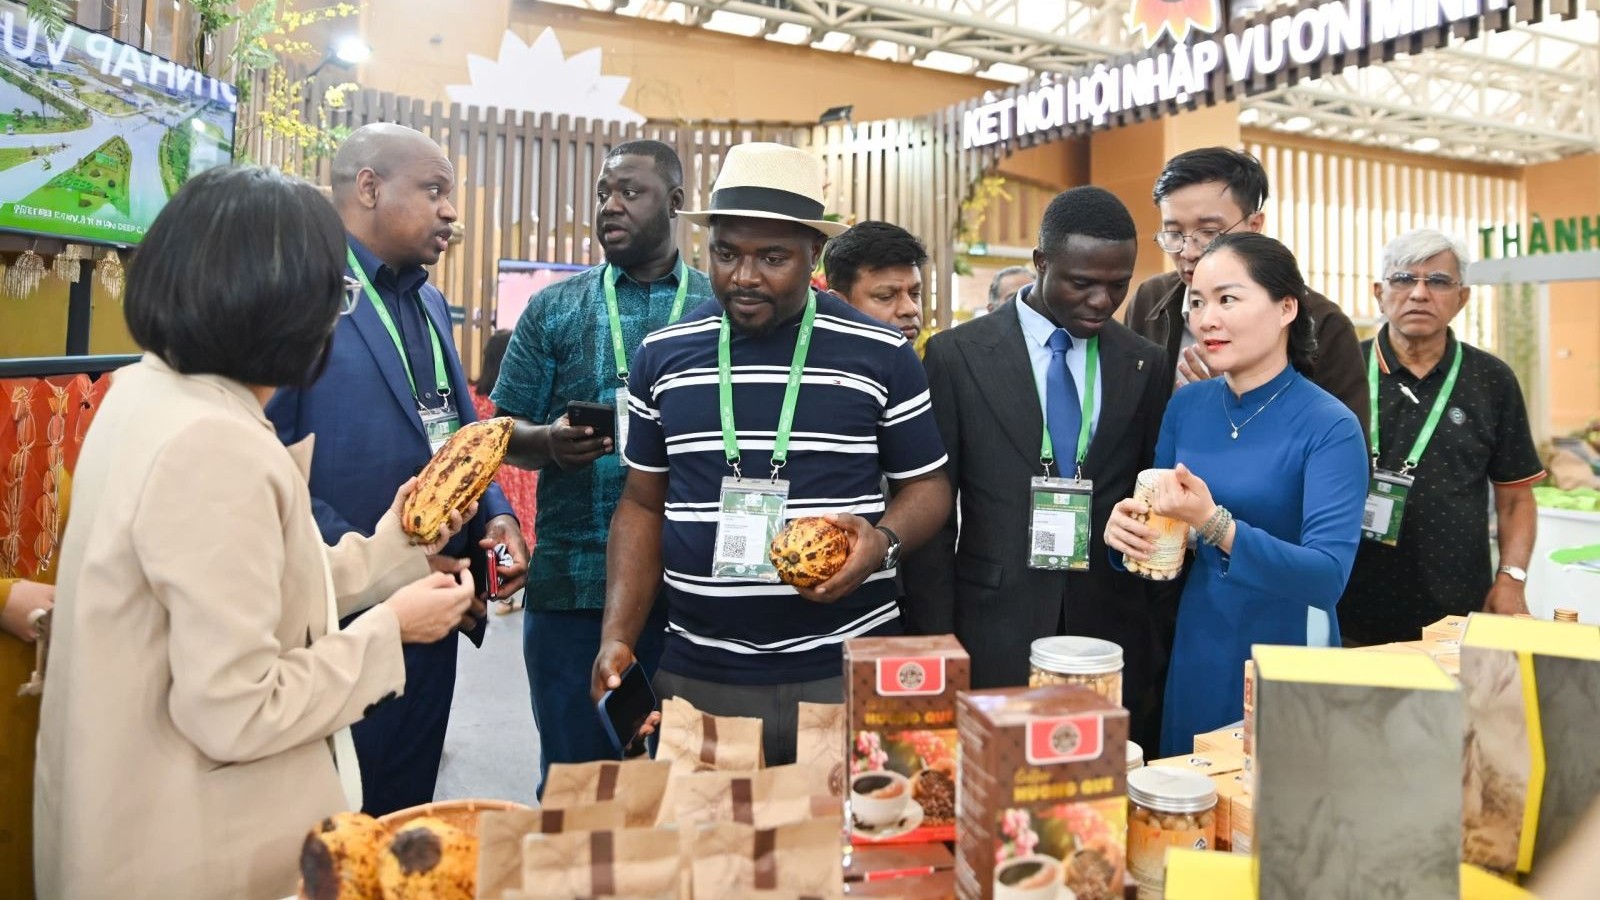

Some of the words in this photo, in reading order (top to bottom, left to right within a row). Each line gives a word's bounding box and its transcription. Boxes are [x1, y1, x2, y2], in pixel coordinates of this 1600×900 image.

[1067, 63, 1119, 125] HỘI
[1123, 40, 1219, 110] NHẬP
[1224, 0, 1361, 81] VƯƠN
[1371, 0, 1507, 44] MI
[1478, 213, 1600, 258] THÀNH
